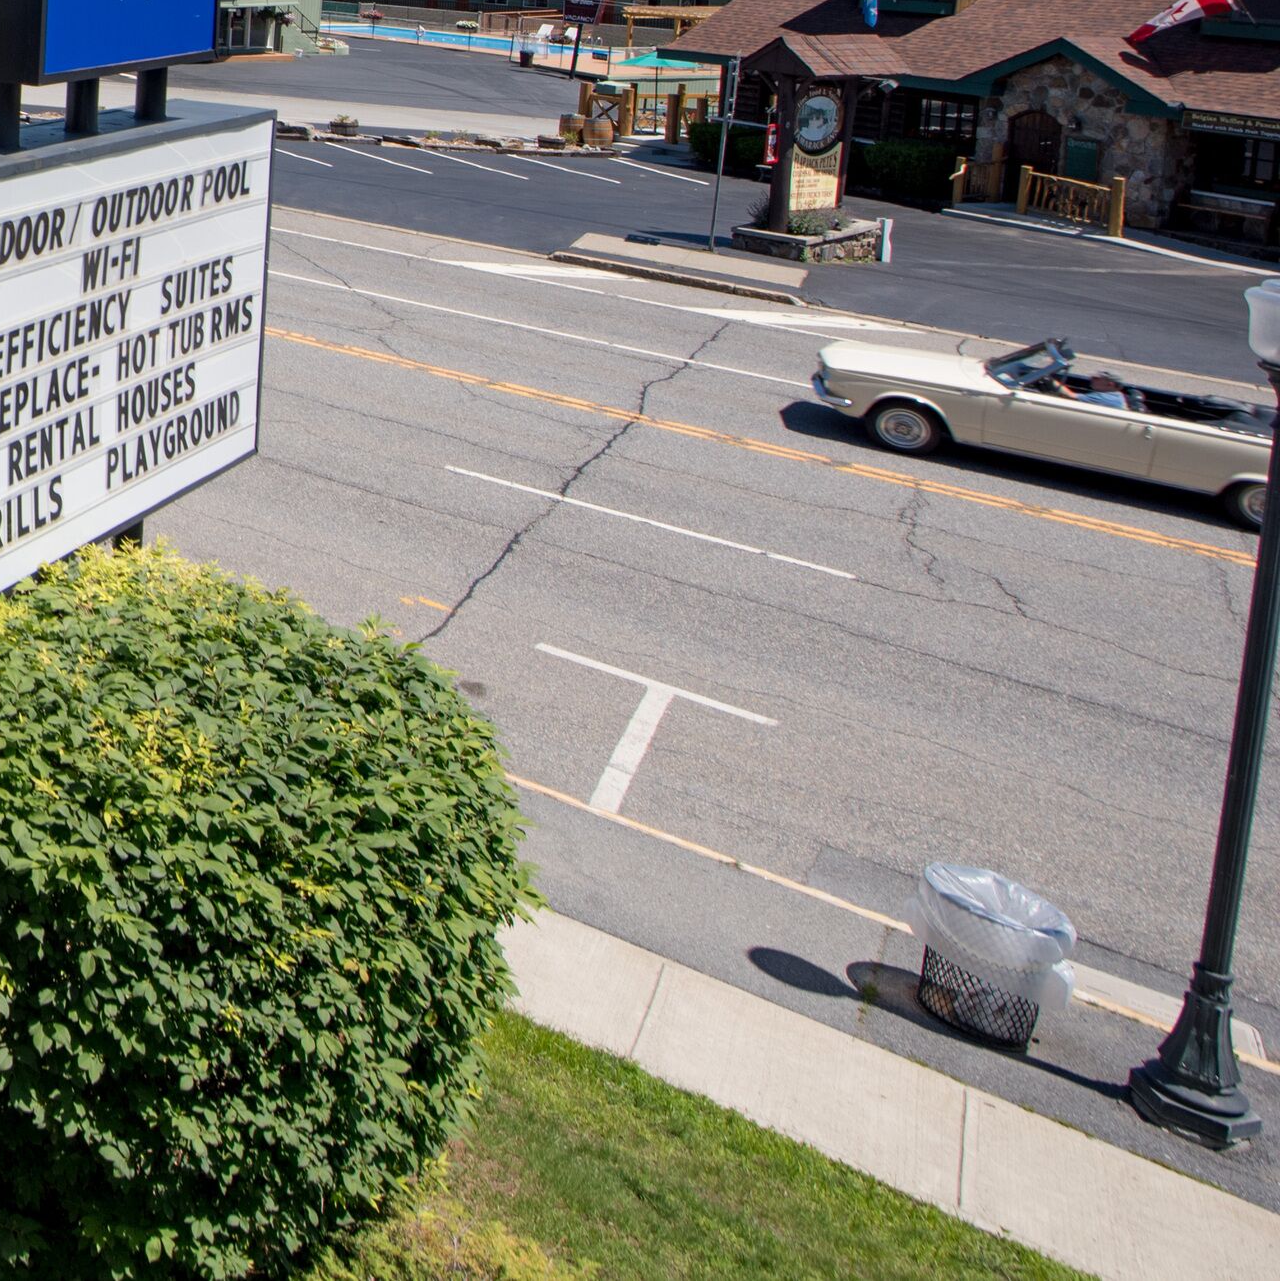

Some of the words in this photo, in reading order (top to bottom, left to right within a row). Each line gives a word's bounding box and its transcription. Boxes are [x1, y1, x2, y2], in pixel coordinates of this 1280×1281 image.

[565, 14, 594, 23] VACANCY
[1191, 113, 1218, 122] Belgian
[1220, 116, 1245, 125] Waffles
[92, 174, 194, 238] OUTDOOR
[201, 160, 251, 207] POOL
[82, 236, 142, 294] WI-FI
[161, 255, 234, 315] SUITES
[117, 328, 160, 382] HOT
[169, 312, 205, 359] TUB
[210, 294, 254, 343] RMS
[8, 406, 100, 487] RENTAL
[117, 361, 196, 433] HOUSES
[106, 390, 241, 490] PLAYGROUND
